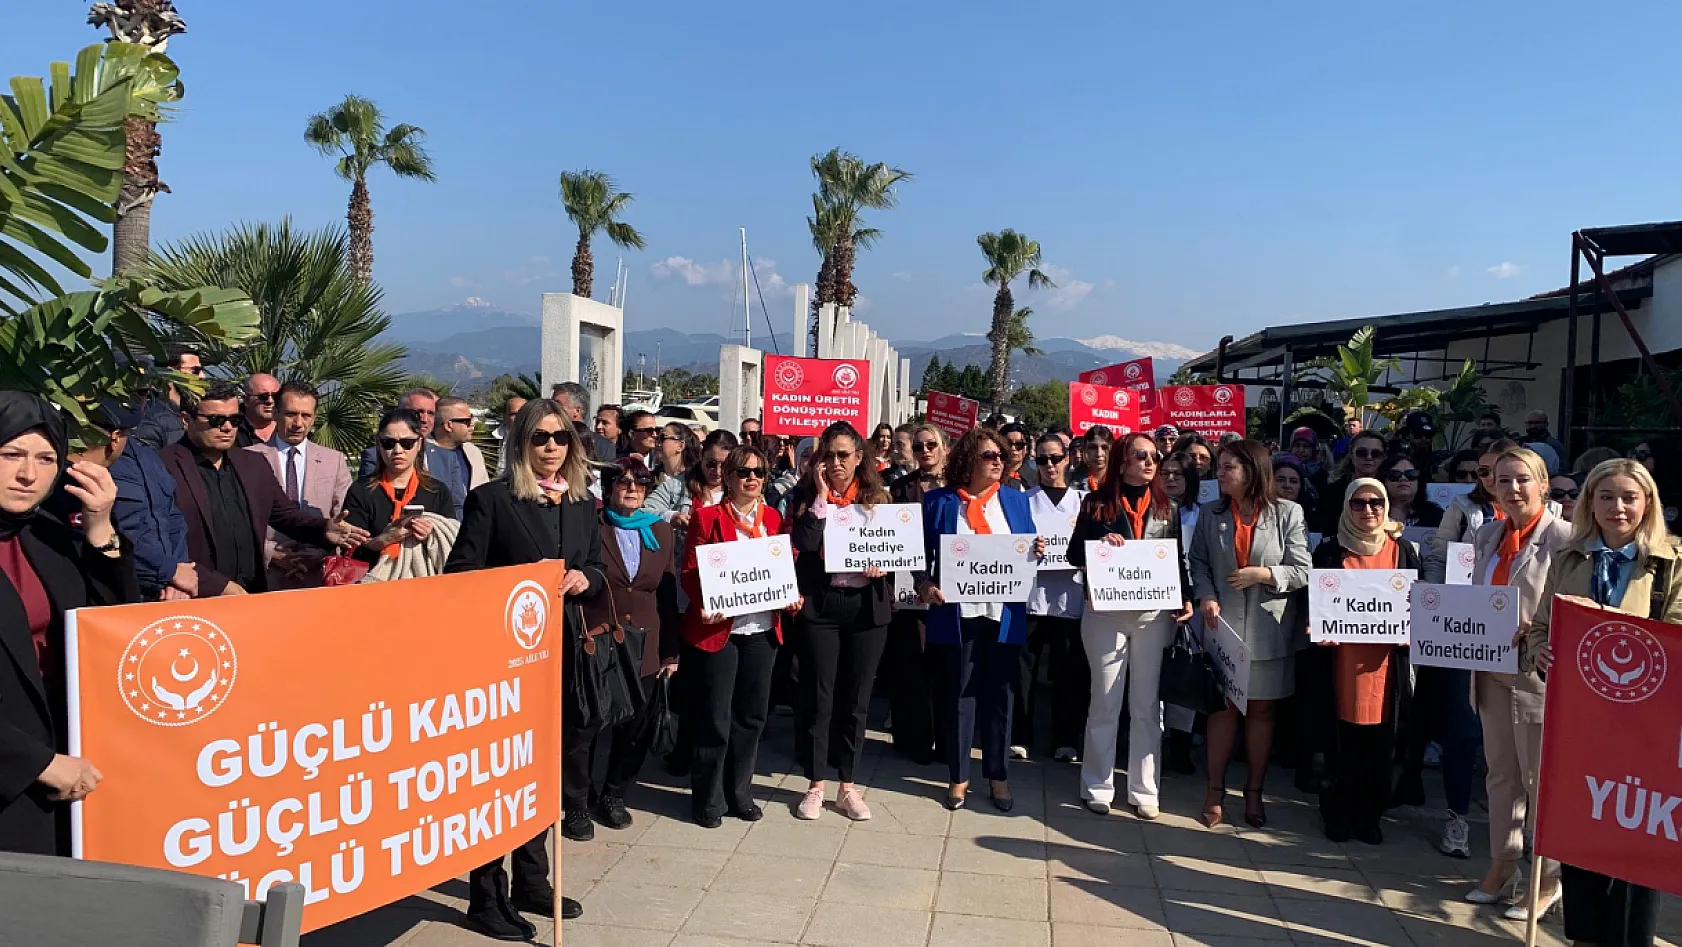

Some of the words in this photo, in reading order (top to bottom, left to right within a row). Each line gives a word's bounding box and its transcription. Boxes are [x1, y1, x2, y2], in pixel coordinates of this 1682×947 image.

[772, 393, 811, 403] KADIN
[815, 394, 860, 405] ÜRETİR
[773, 405, 859, 416] DÖNÜŞTÜRÜR
[1091, 408, 1119, 419] KADIN
[1170, 410, 1236, 418] KADINLARLA
[1175, 419, 1231, 427] YÜKSELEN
[859, 526, 896, 537] Kadın
[1045, 534, 1069, 545] adın
[849, 541, 904, 554] Belediye
[969, 561, 1013, 575] Kadın
[1118, 566, 1151, 580] Kadın
[731, 567, 771, 584] Kadın
[956, 580, 1022, 596] Validir!”
[1093, 586, 1176, 601] Mühendistir!”
[709, 584, 794, 610] Muhtardır!”
[1346, 597, 1392, 612] Kadın
[1444, 617, 1485, 635] Kadın
[1417, 639, 1510, 662] Yöneticidir!”
[197, 702, 393, 787] GÜÇLÜ
[409, 677, 521, 742] KADIN
[163, 777, 372, 868] GÜÇLÜ
[388, 729, 534, 811] TOPLUM
[382, 781, 537, 876] TÜRKİYE
